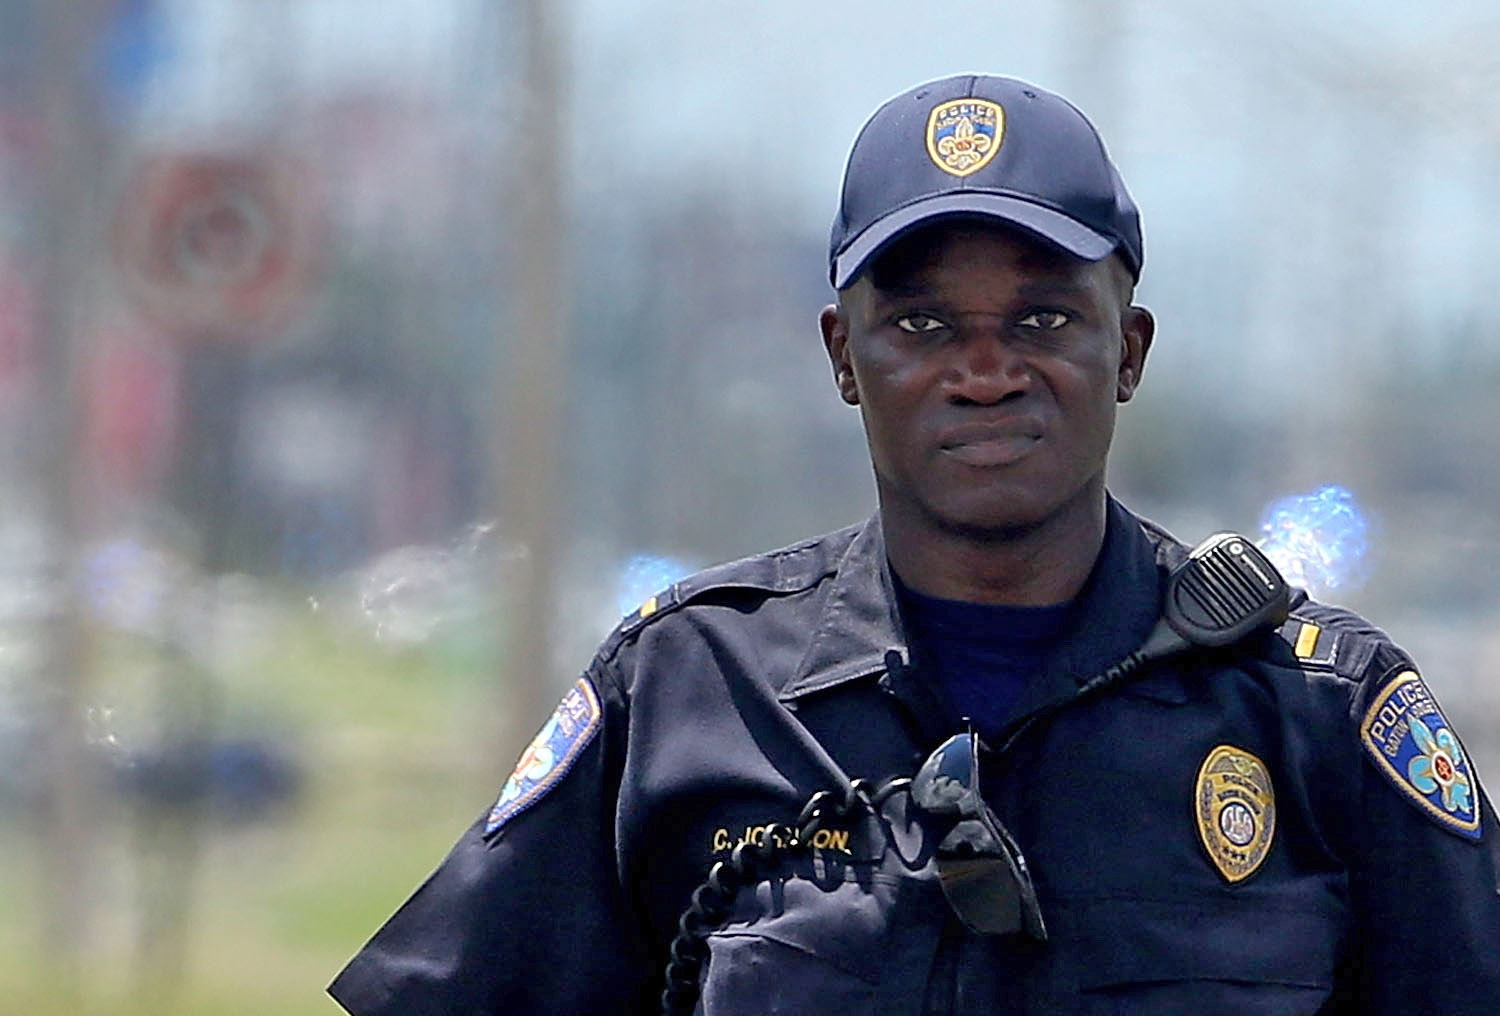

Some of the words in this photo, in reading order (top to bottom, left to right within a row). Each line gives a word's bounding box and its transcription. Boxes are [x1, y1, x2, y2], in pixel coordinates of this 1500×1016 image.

[939, 105, 993, 119] POLICE
[1371, 682, 1428, 743] POLICE
[714, 828, 732, 850] C.
